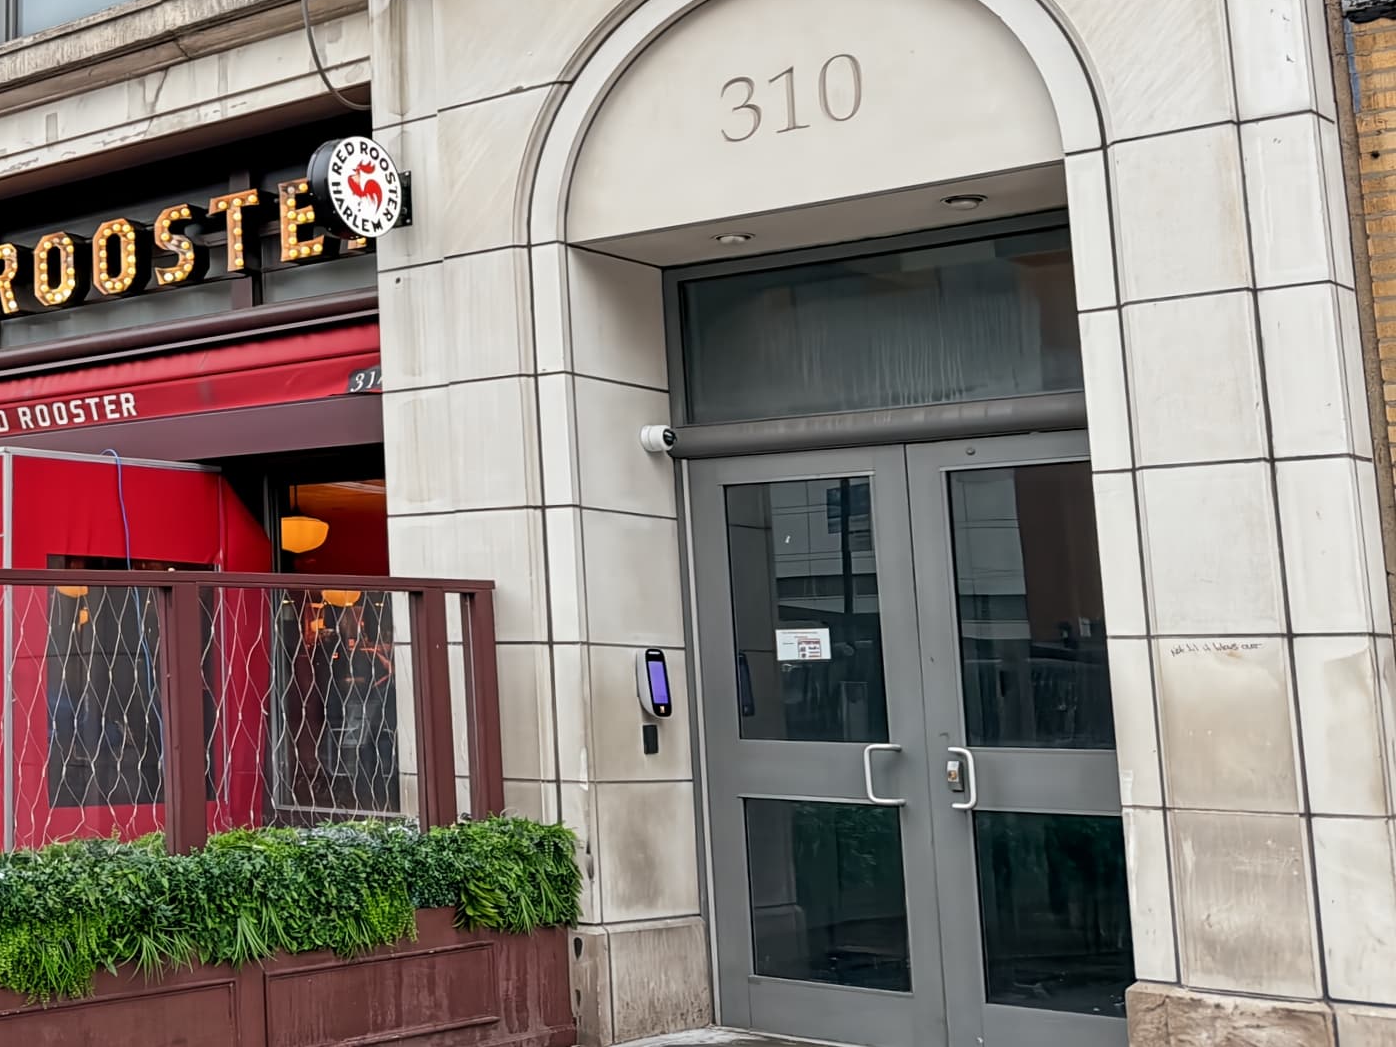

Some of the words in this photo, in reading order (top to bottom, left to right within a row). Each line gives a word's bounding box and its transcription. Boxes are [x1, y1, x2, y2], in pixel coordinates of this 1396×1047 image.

[719, 53, 862, 143] 310
[331, 181, 383, 232] HARLEM
[332, 141, 355, 175] RED
[359, 141, 399, 222] ROOSTER
[350, 370, 382, 393] 31
[20, 392, 138, 430] ROOSTER
